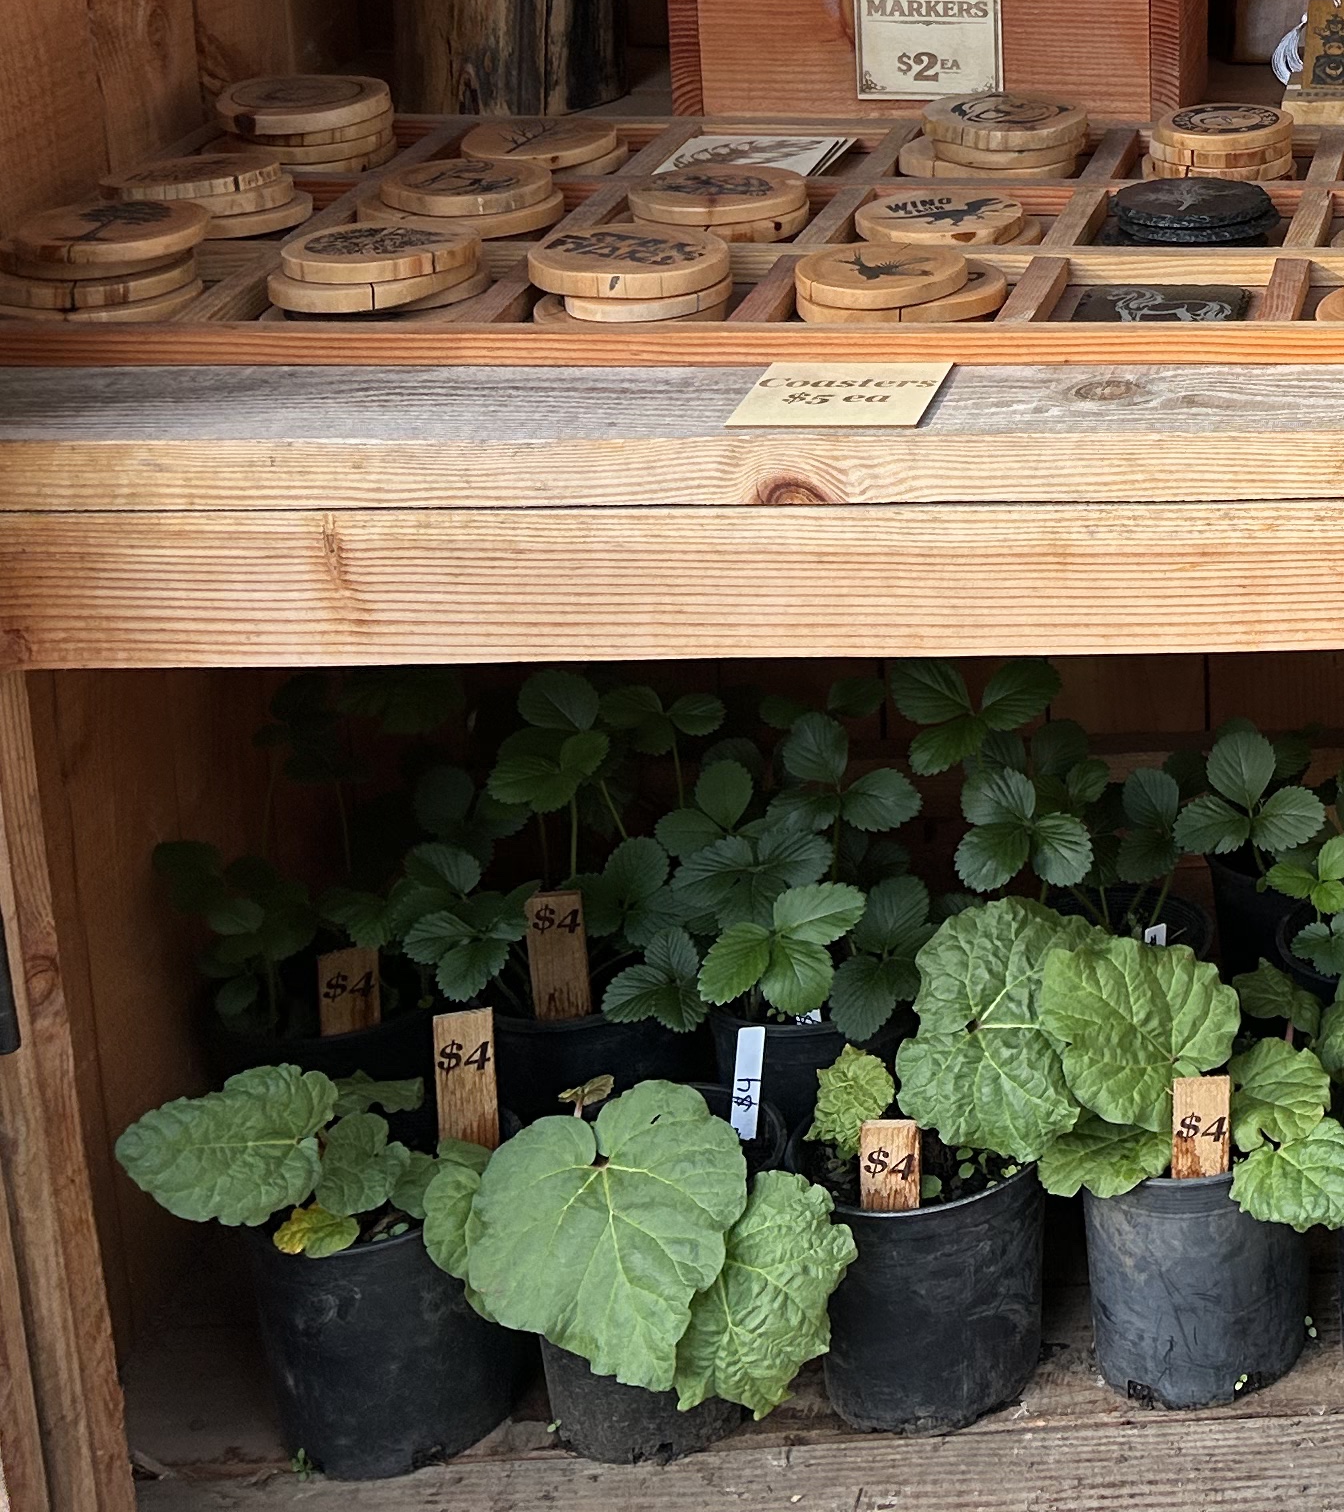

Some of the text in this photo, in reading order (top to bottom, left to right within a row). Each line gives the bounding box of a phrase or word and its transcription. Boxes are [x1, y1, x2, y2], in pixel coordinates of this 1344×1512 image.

[866, 0, 989, 19] MARKERS
[897, 51, 961, 82] $2 EA
[885, 197, 952, 214] WINO
[758, 377, 939, 389] Coasters
[782, 391, 892, 405] $5 ea
[533, 904, 580, 936] $4
[323, 971, 375, 1002] $4
[437, 1040, 491, 1074] $4
[732, 1076, 760, 1113] $4
[1176, 1113, 1227, 1144] $4
[863, 1148, 915, 1182] $4
